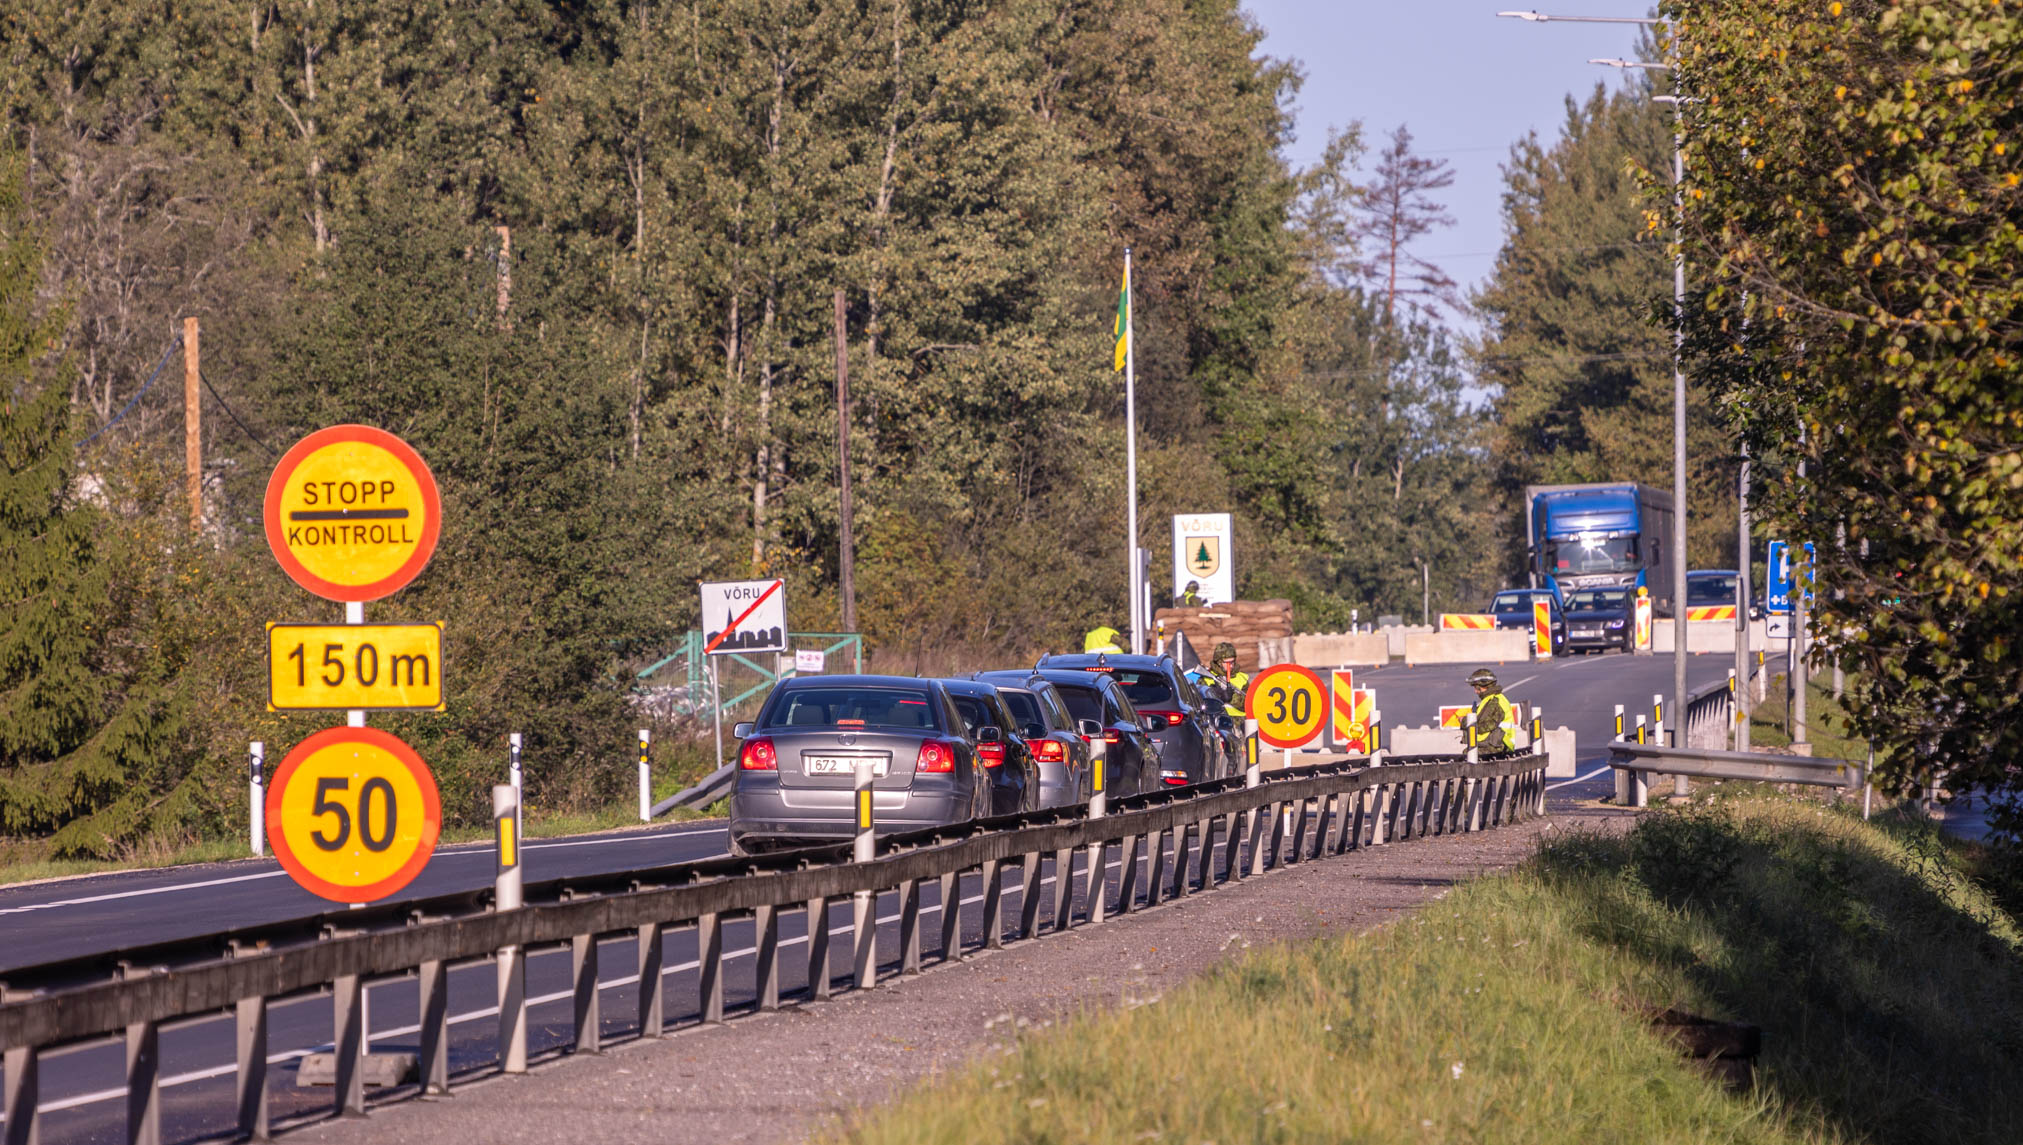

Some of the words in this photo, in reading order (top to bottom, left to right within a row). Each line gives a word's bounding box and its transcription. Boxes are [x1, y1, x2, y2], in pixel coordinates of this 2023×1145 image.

[303, 481, 394, 506] STOPP
[288, 525, 414, 546] KONTROLL
[1181, 519, 1223, 532] VÕRU
[724, 586, 760, 600] VÕRU
[1266, 687, 1312, 725] 30
[815, 759, 837, 771] 672
[311, 776, 397, 853] 50
